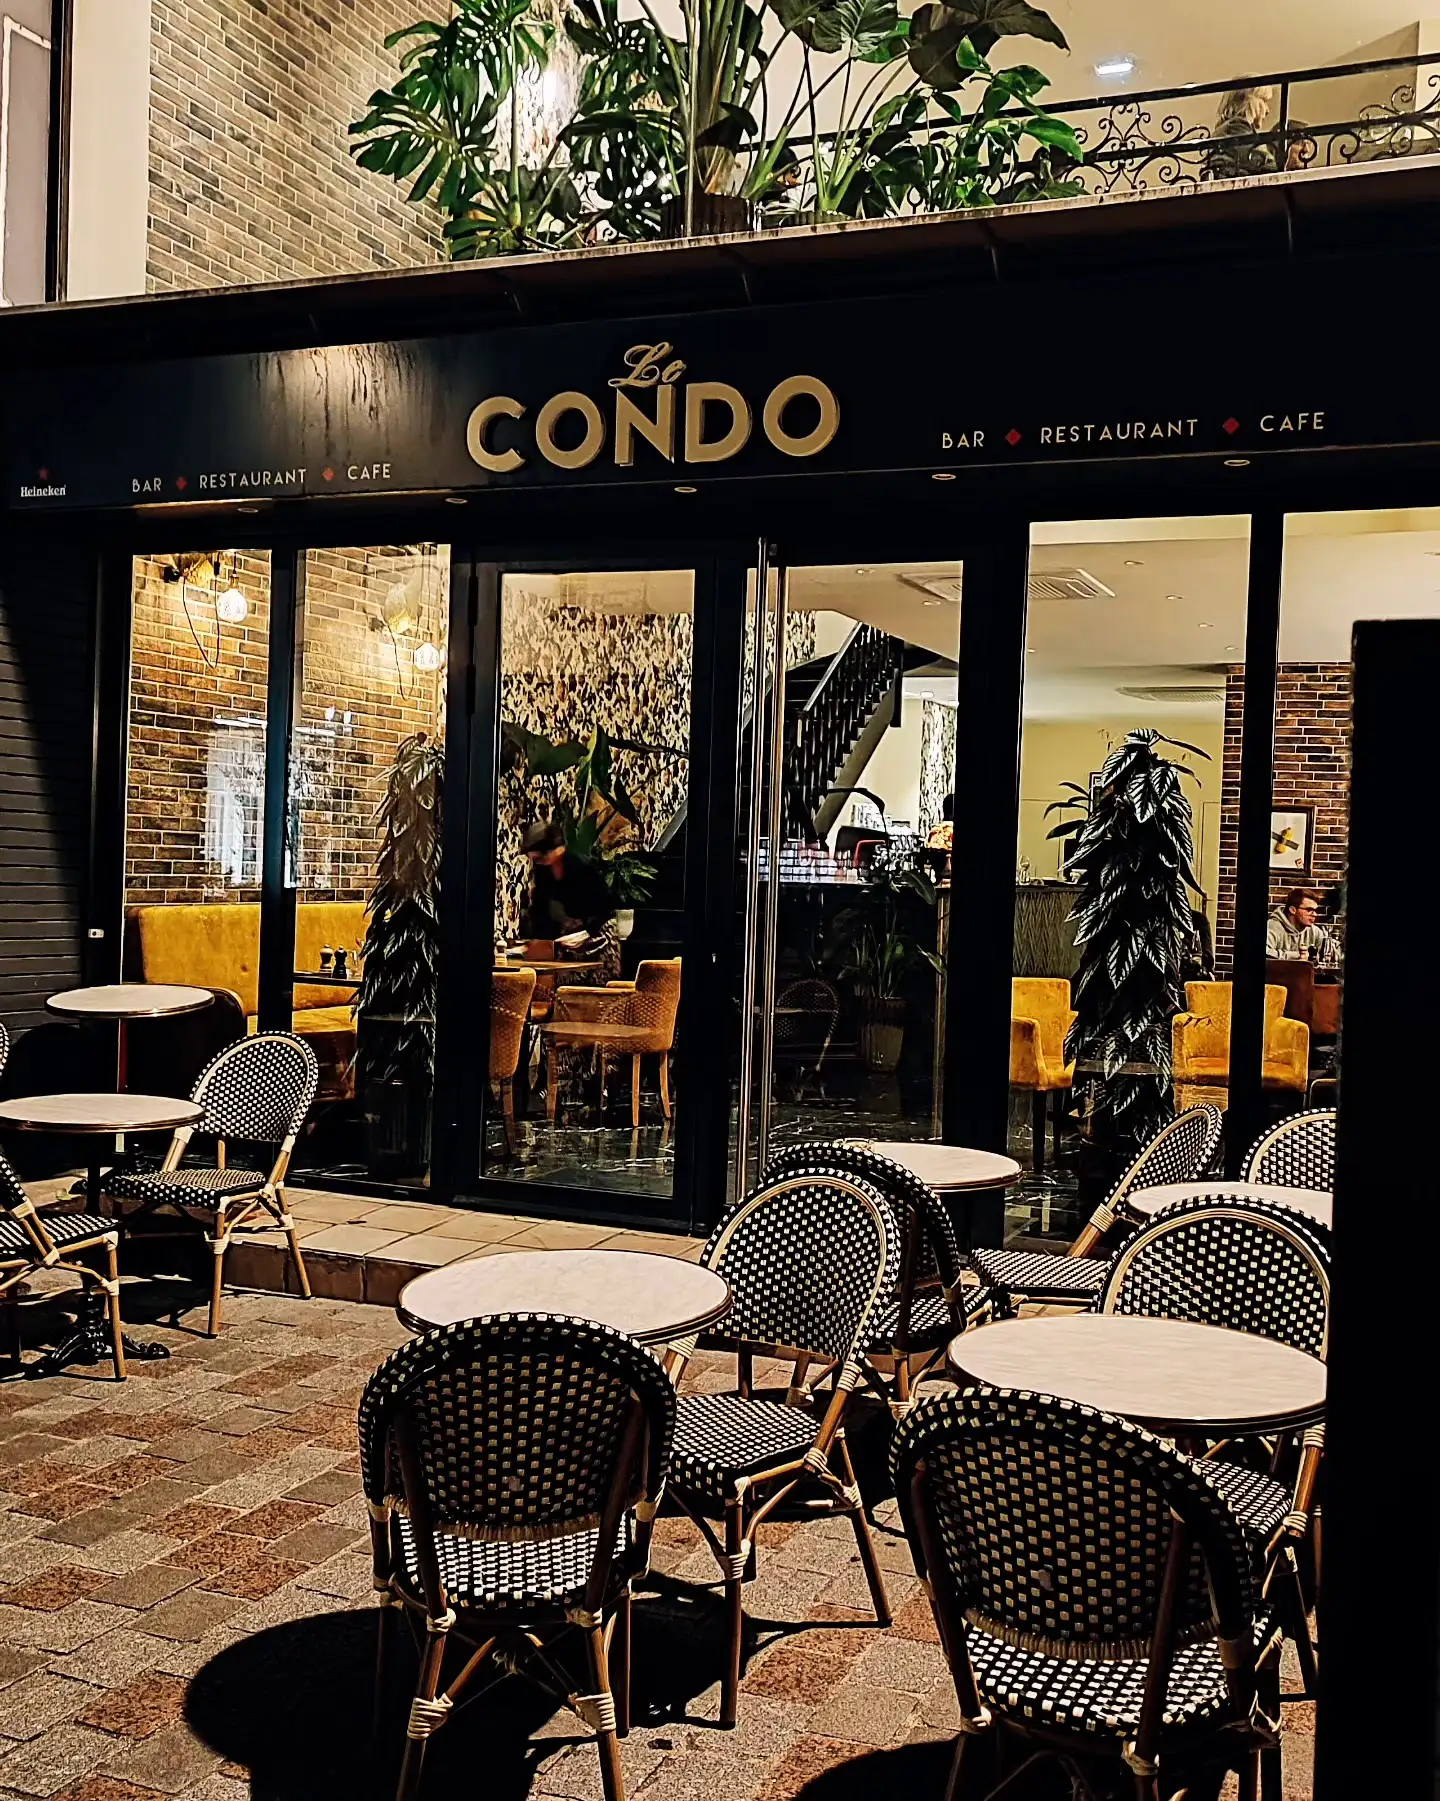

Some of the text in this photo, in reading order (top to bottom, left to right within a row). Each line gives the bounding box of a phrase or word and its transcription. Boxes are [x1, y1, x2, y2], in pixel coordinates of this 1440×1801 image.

[607, 341, 687, 388] Le
[466, 374, 840, 472] CONDO
[941, 411, 1325, 449] BAR RESTAURANT CAFE
[20, 484, 66, 498] Heineken
[132, 463, 391, 493] BAR RESTAURANT CAFE
